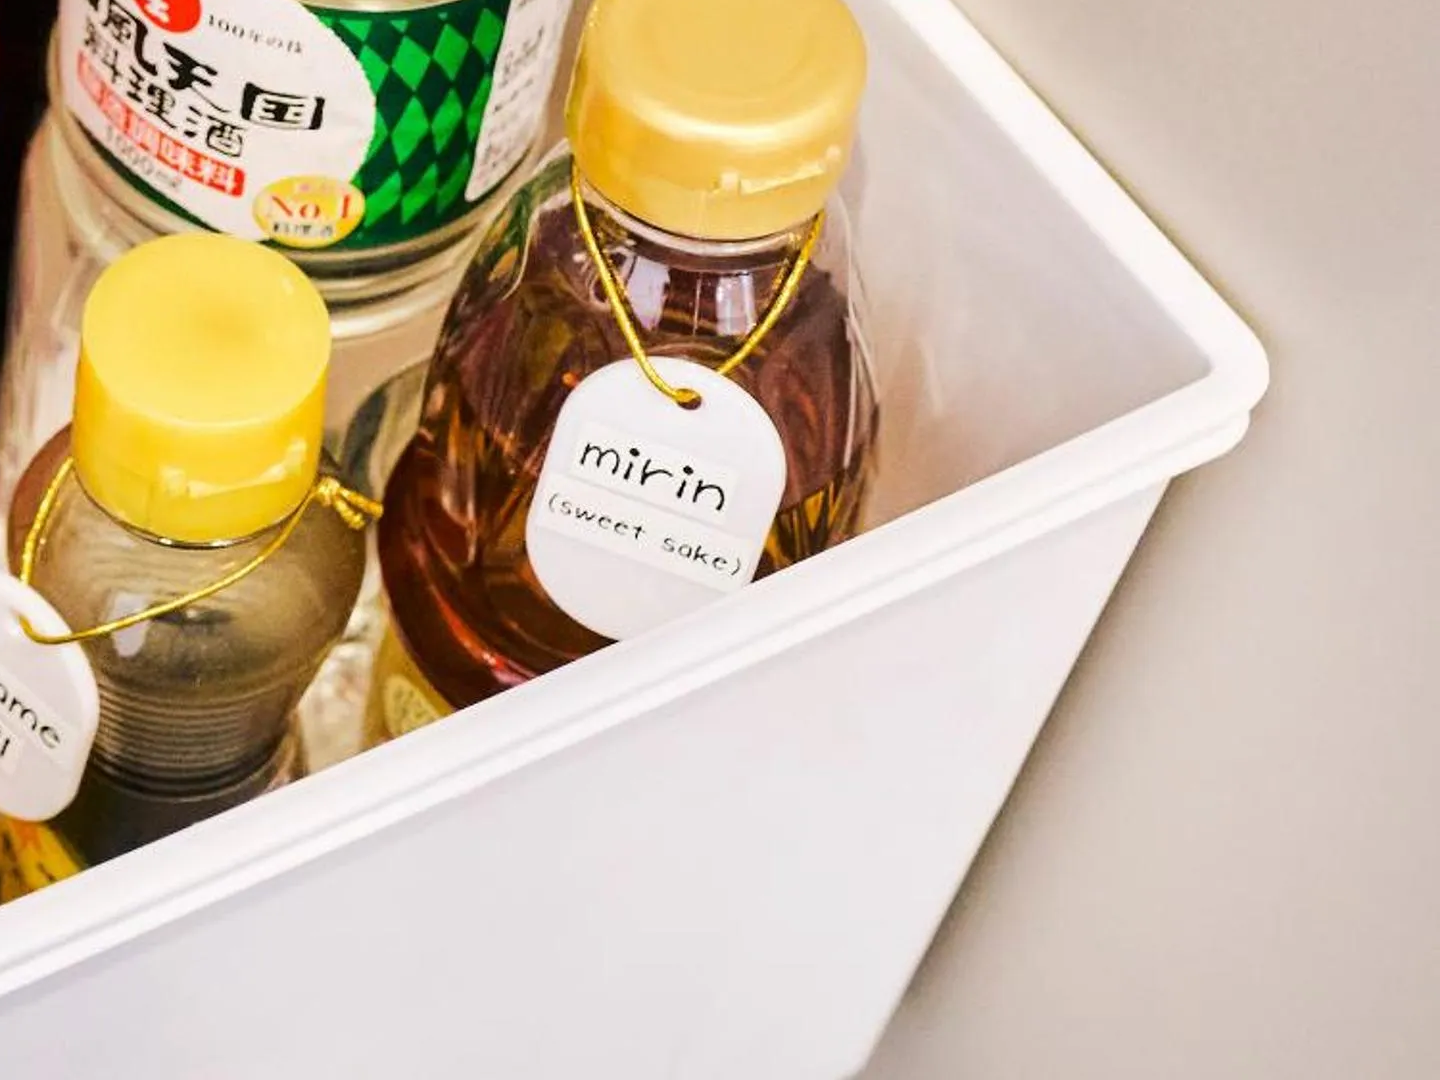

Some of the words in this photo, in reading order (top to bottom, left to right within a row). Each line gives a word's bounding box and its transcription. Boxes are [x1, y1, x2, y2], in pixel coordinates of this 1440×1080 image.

[580, 441, 726, 511] mirin
[548, 492, 646, 539] (sweet
[662, 537, 742, 576] sake)
